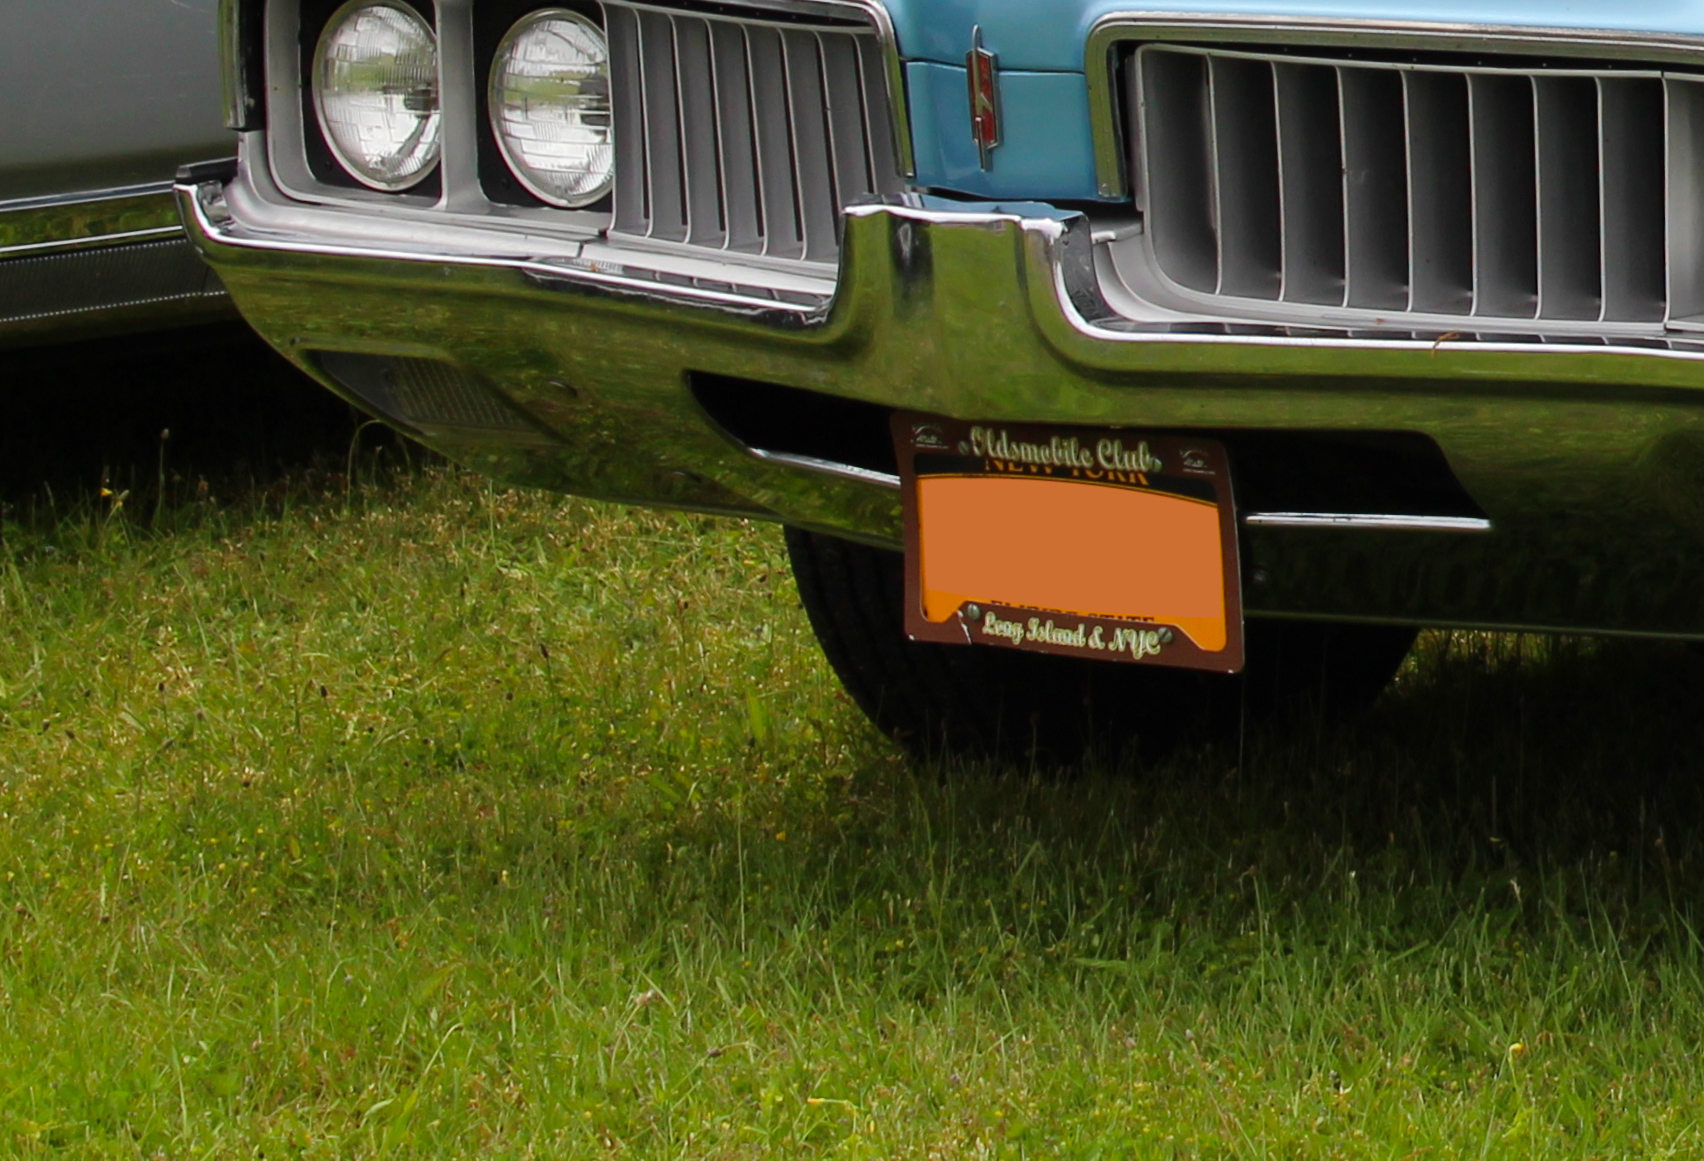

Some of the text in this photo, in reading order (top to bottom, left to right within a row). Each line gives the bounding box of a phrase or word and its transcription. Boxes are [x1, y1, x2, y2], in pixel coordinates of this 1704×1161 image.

[970, 426, 1093, 468] Oldsmobile
[1096, 438, 1151, 473] Club
[982, 611, 1160, 660] Long Island & NYC
